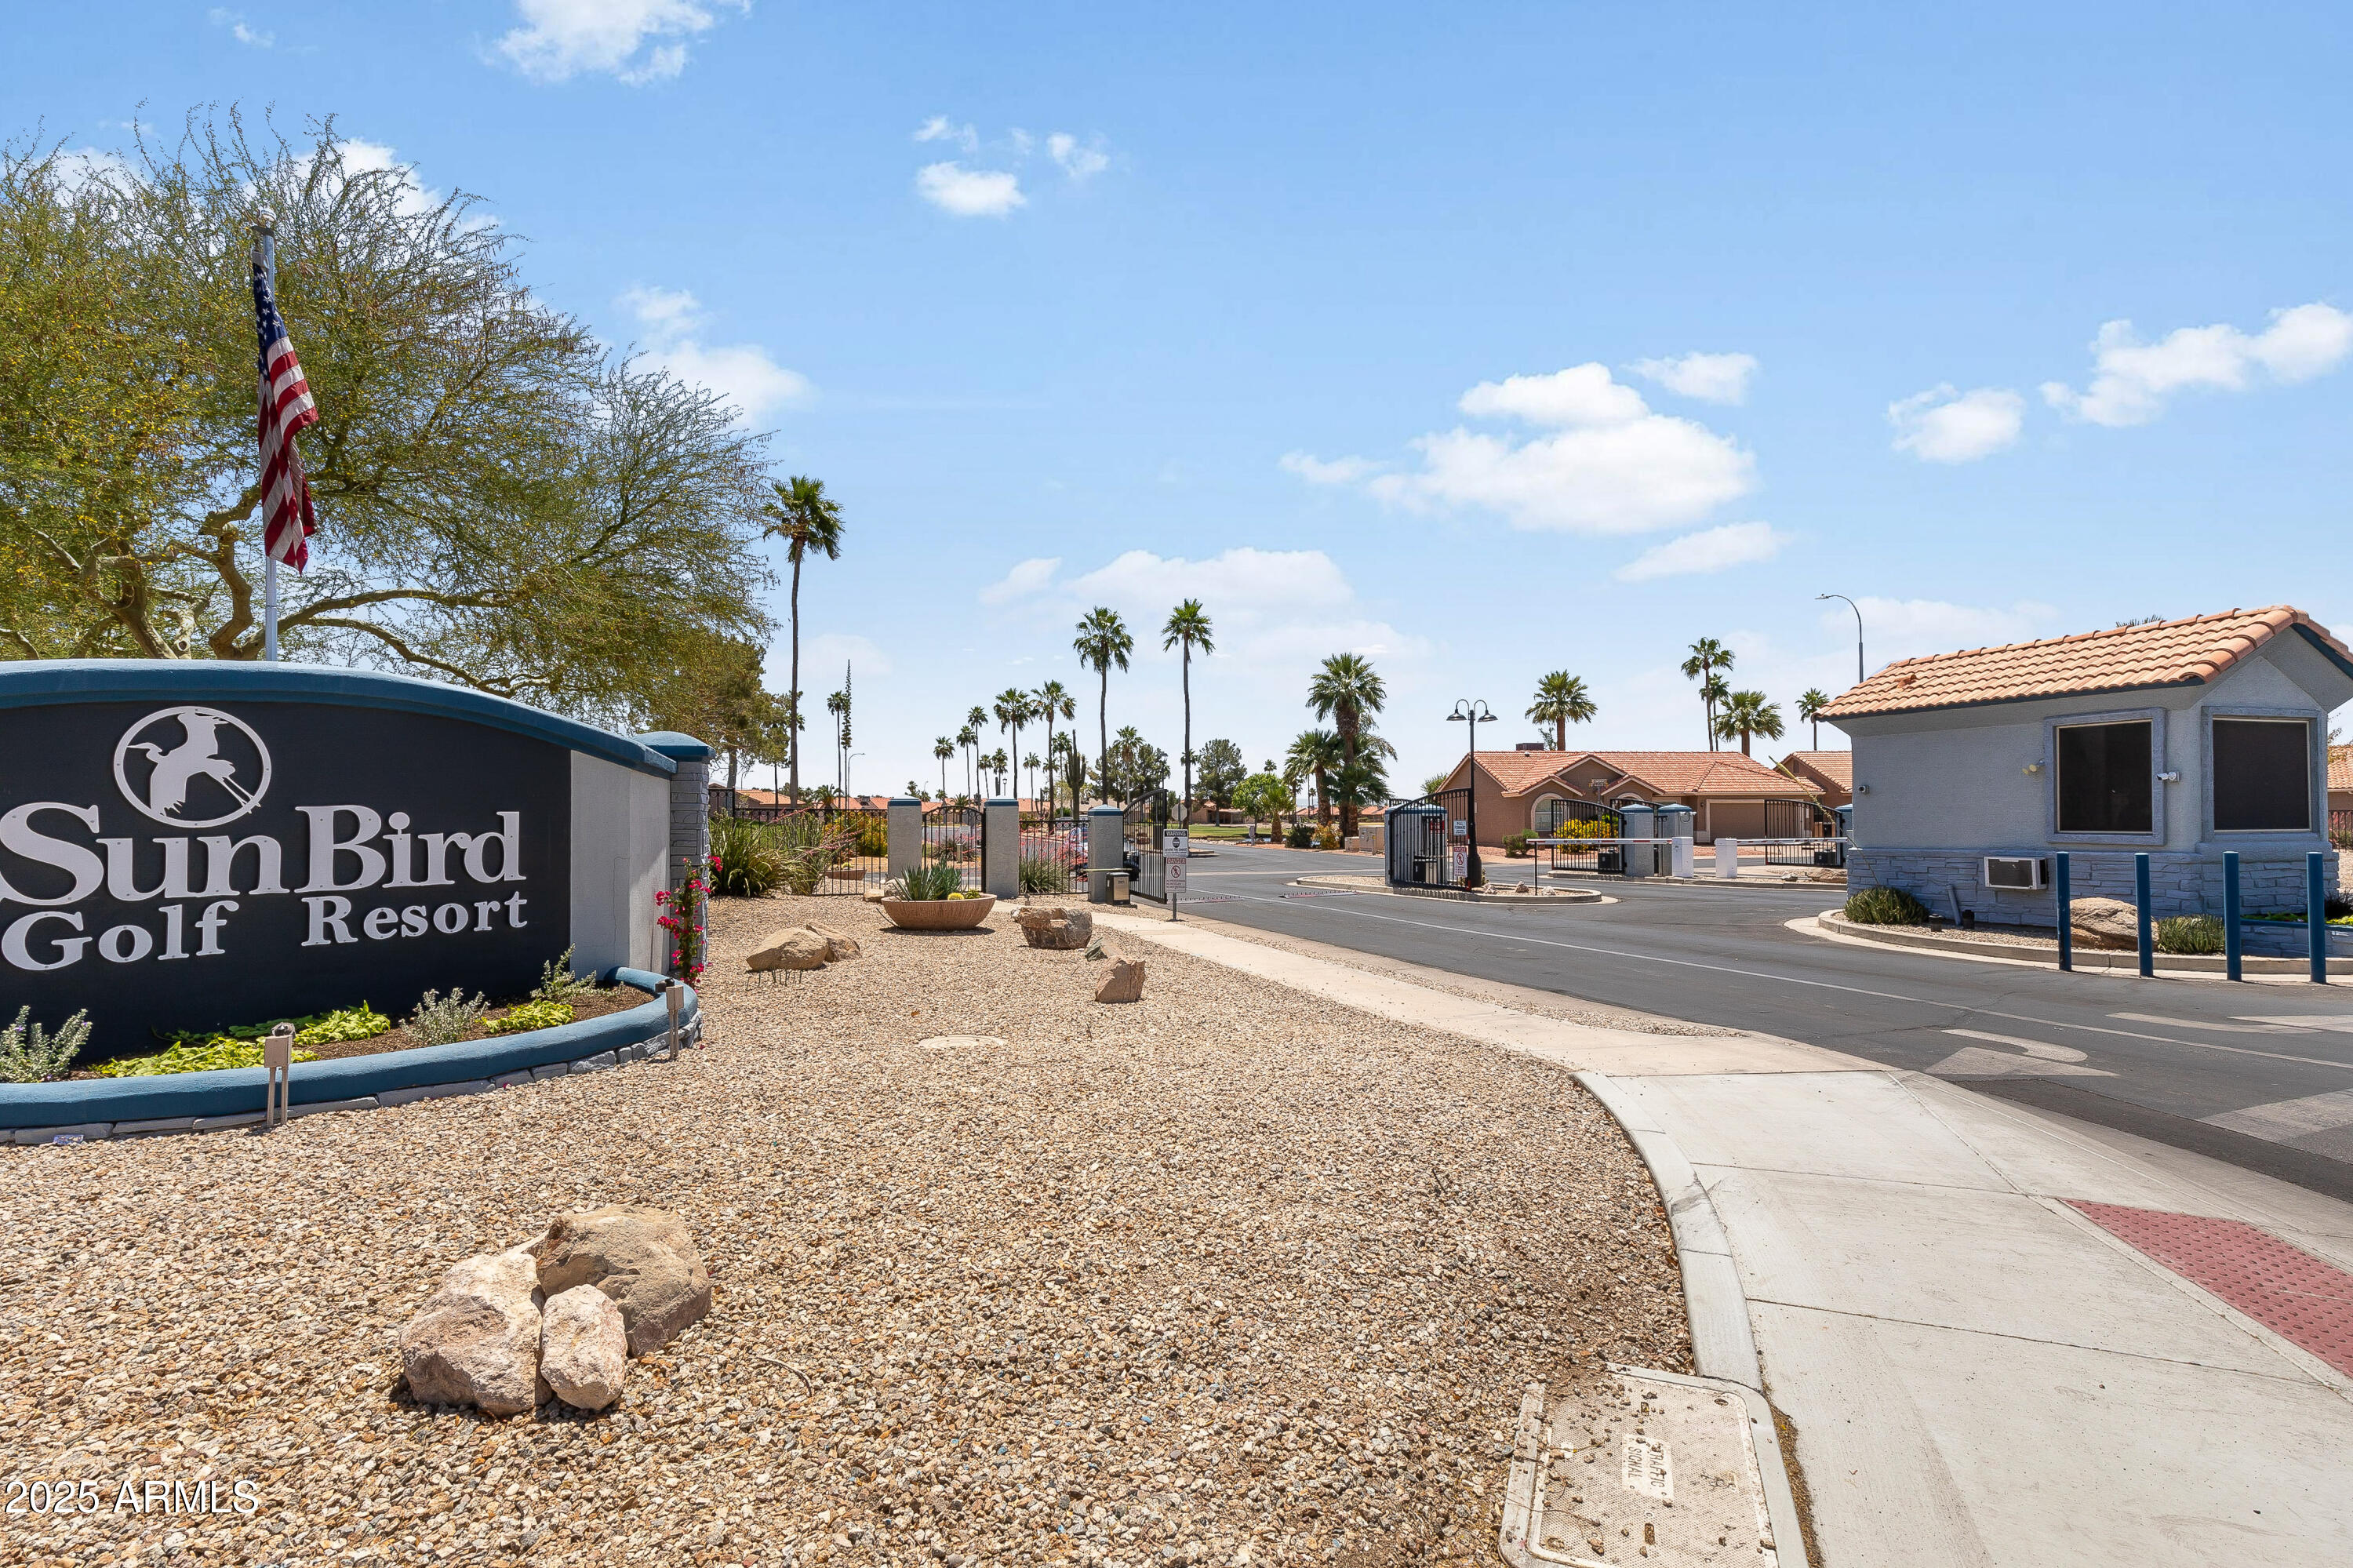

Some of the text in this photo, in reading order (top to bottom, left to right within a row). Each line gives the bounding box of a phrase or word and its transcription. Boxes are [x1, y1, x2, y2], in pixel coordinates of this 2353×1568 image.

[2, 891, 527, 970] Golf Resort
[1627, 1446, 1642, 1478] SIGNAL
